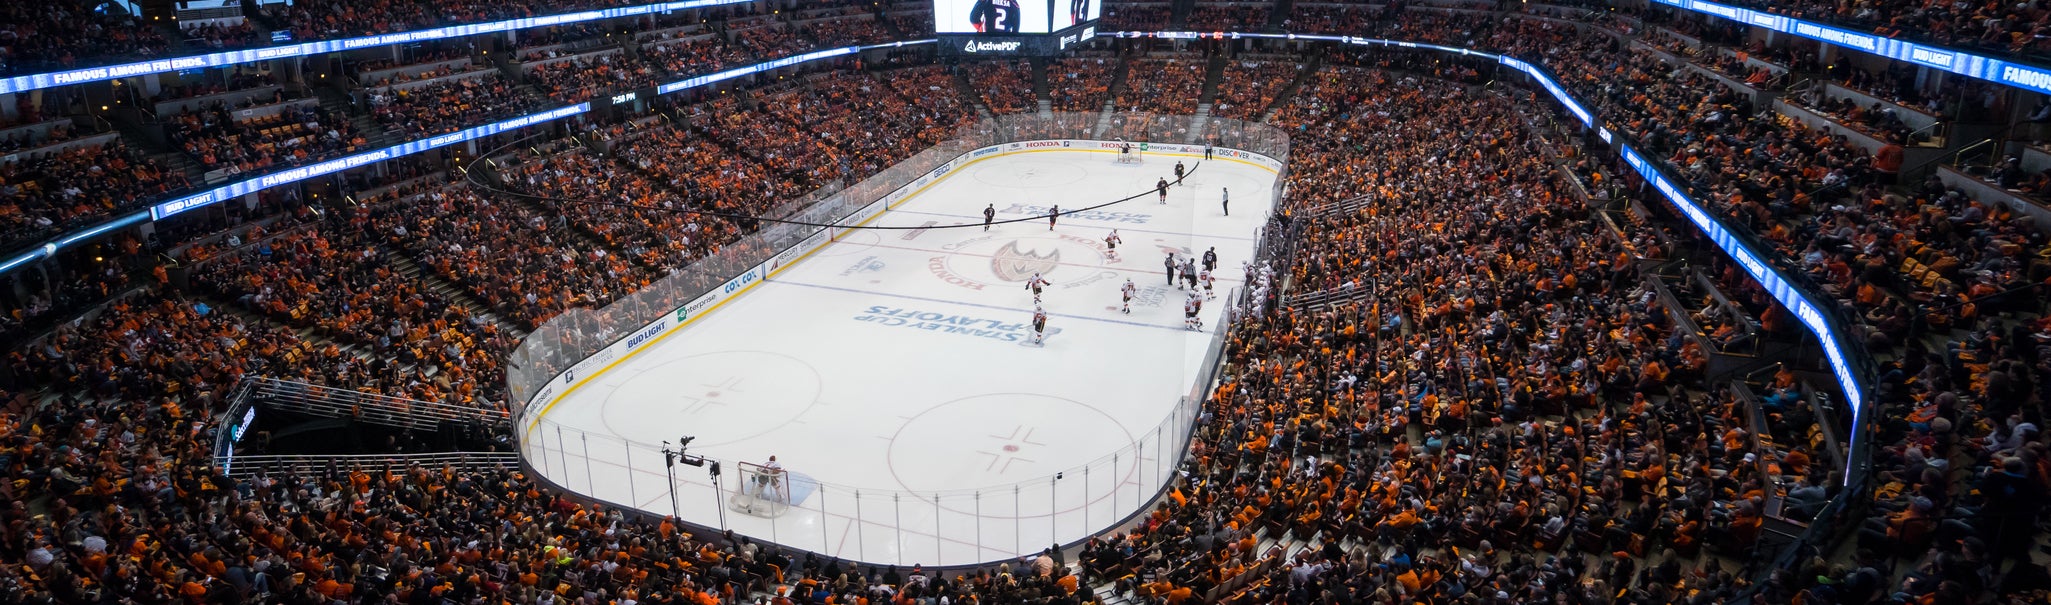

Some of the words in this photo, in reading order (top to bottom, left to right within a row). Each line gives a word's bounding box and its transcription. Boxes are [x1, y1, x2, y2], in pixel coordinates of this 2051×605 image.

[994, 8, 1007, 30] 2
[344, 38, 380, 48] FAMOUS
[381, 34, 410, 44] AMONG
[977, 41, 1018, 51] ActivePDF
[258, 49, 276, 58] BUD
[276, 47, 300, 57] LIGHT
[1913, 48, 1929, 61] BUD
[1929, 51, 1952, 67] LIGHT
[54, 68, 107, 85] FAMOUS
[109, 63, 151, 77] AMONG
[153, 57, 206, 73] FRIENDS.
[262, 170, 308, 187] FAMOUS
[309, 160, 346, 178] AMONG
[346, 150, 389, 168] FRIENDS.
[934, 164, 950, 178] GEICO
[165, 201, 184, 214] BUD
[185, 193, 212, 208] LIGHT
[725, 281, 740, 294] COX
[742, 271, 757, 284] COX
[678, 294, 717, 320] enterprise
[853, 315, 907, 327] CUP
[864, 305, 1023, 332] PLAYOFFS
[627, 333, 644, 349] BUD
[644, 321, 666, 339] LIGHT
[908, 321, 1024, 342] STANLEY
